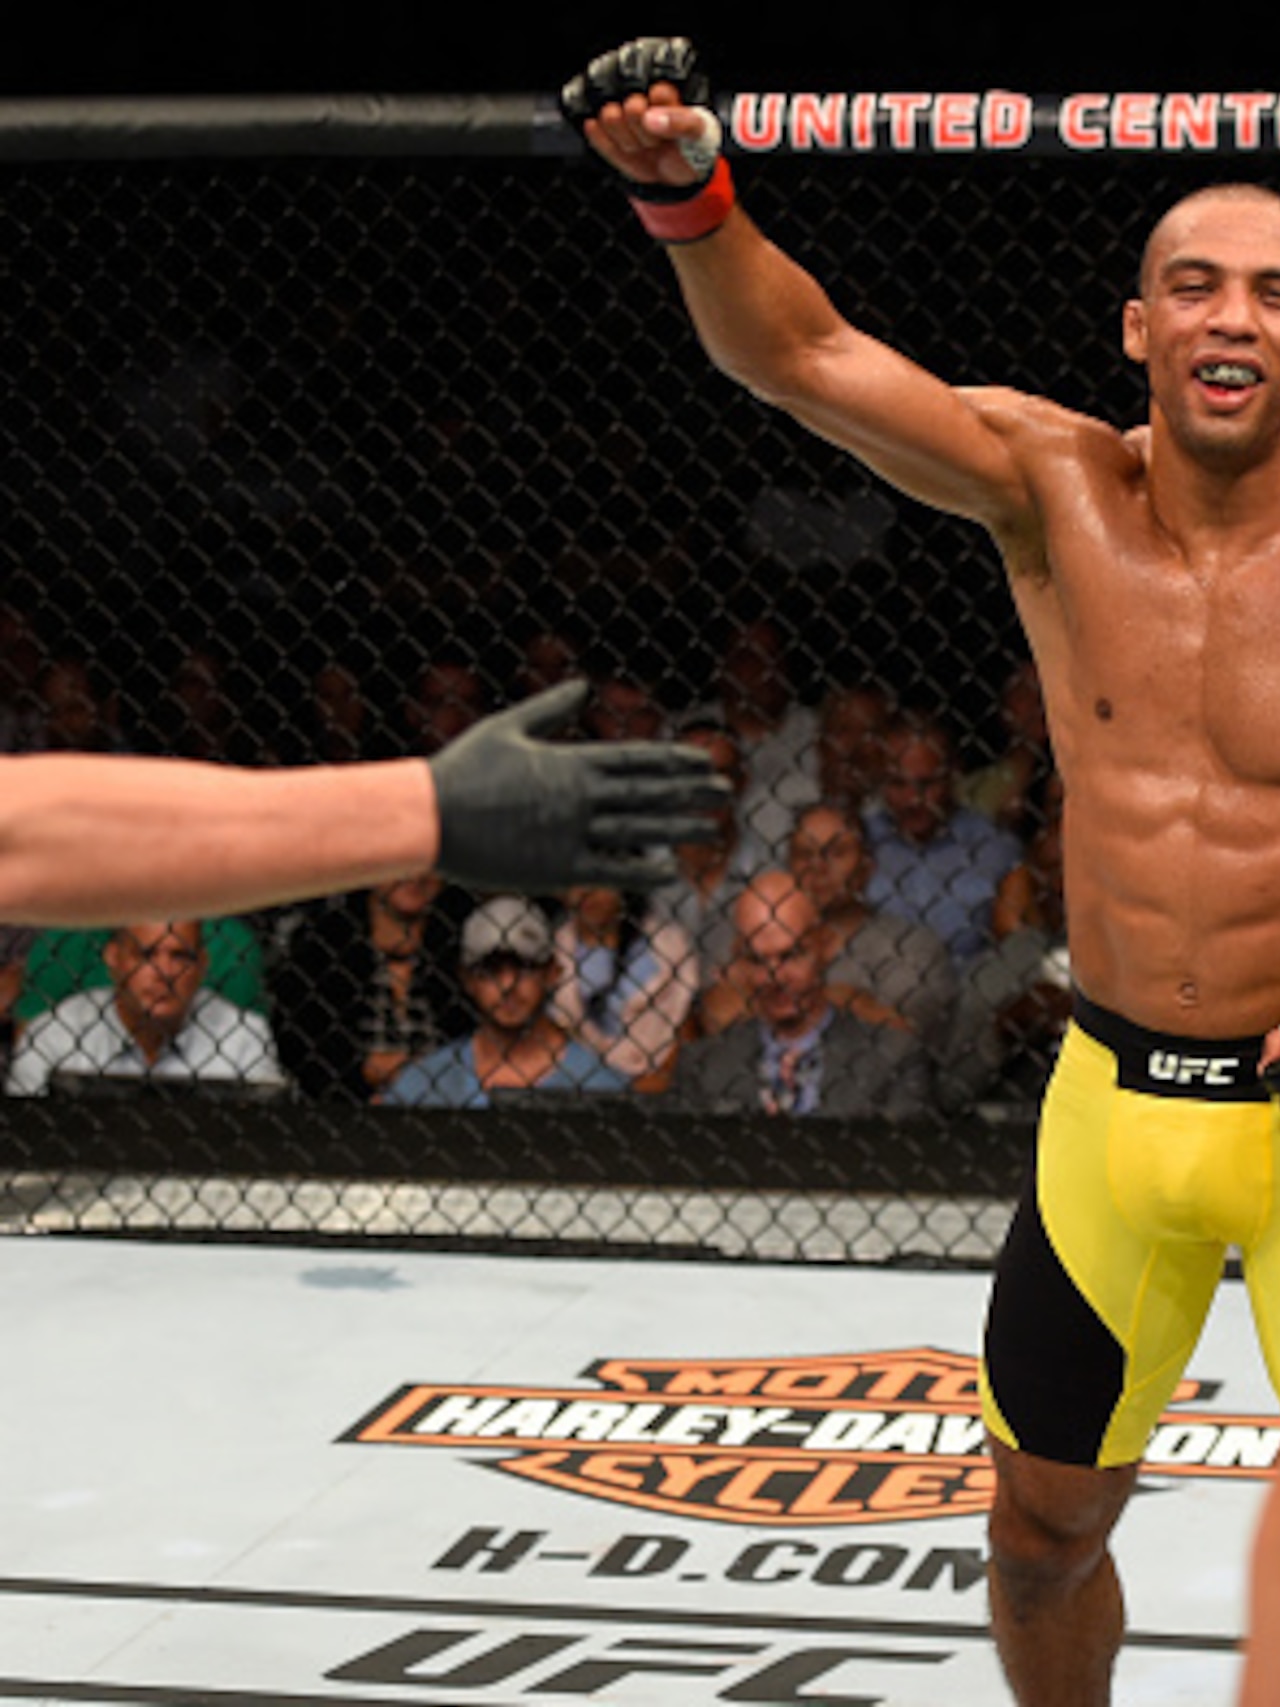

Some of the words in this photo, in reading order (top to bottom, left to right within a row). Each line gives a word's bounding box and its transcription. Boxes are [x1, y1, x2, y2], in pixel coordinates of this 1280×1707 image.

[729, 91, 1034, 151] UNITED
[1147, 1049, 1240, 1087] UFC
[322, 1628, 957, 1707] UFC
